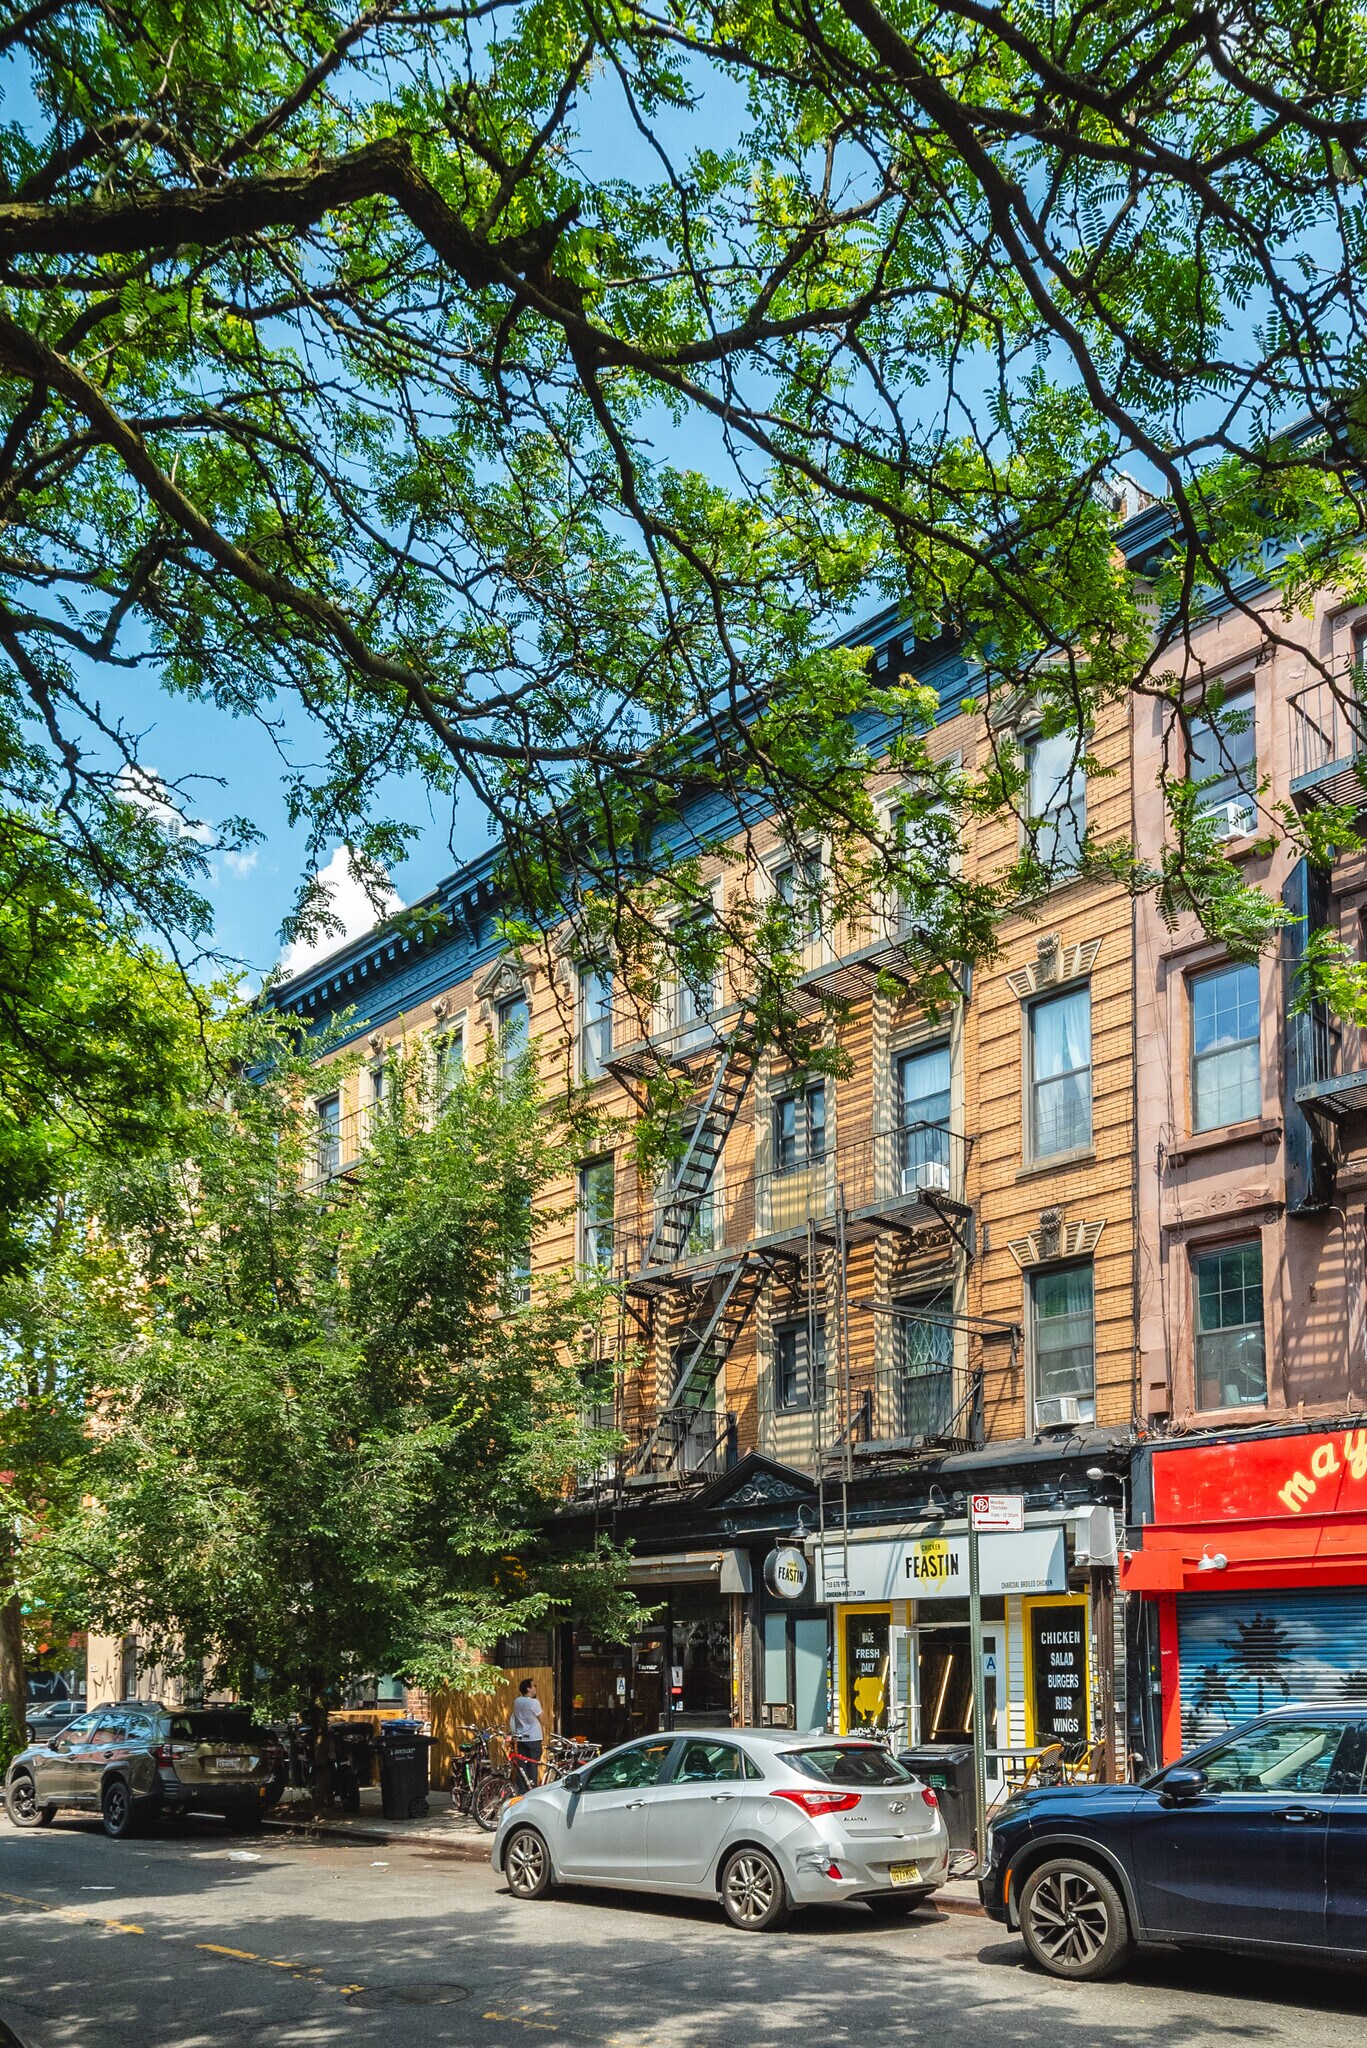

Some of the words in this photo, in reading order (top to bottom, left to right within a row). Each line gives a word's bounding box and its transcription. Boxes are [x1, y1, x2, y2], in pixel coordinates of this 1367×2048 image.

[921, 1543, 941, 1551] CHICKEN
[905, 1553, 959, 1578] FEASTIN
[778, 1566, 804, 1583] FEASTIN
[1036, 1579, 1053, 1587] CHICKEN
[861, 1632, 874, 1643] MADE
[1041, 1631, 1080, 1645] CHICKEN
[856, 1648, 880, 1659] FRESH
[1050, 1652, 1074, 1667] SALAD
[861, 1662, 876, 1673] DAILY
[986, 1656, 996, 1670] A
[618, 1679, 625, 1690] A
[1047, 1674, 1079, 1688] BURGERS
[1055, 1696, 1072, 1710] RIBS
[1053, 1718, 1079, 1732] WINGS
